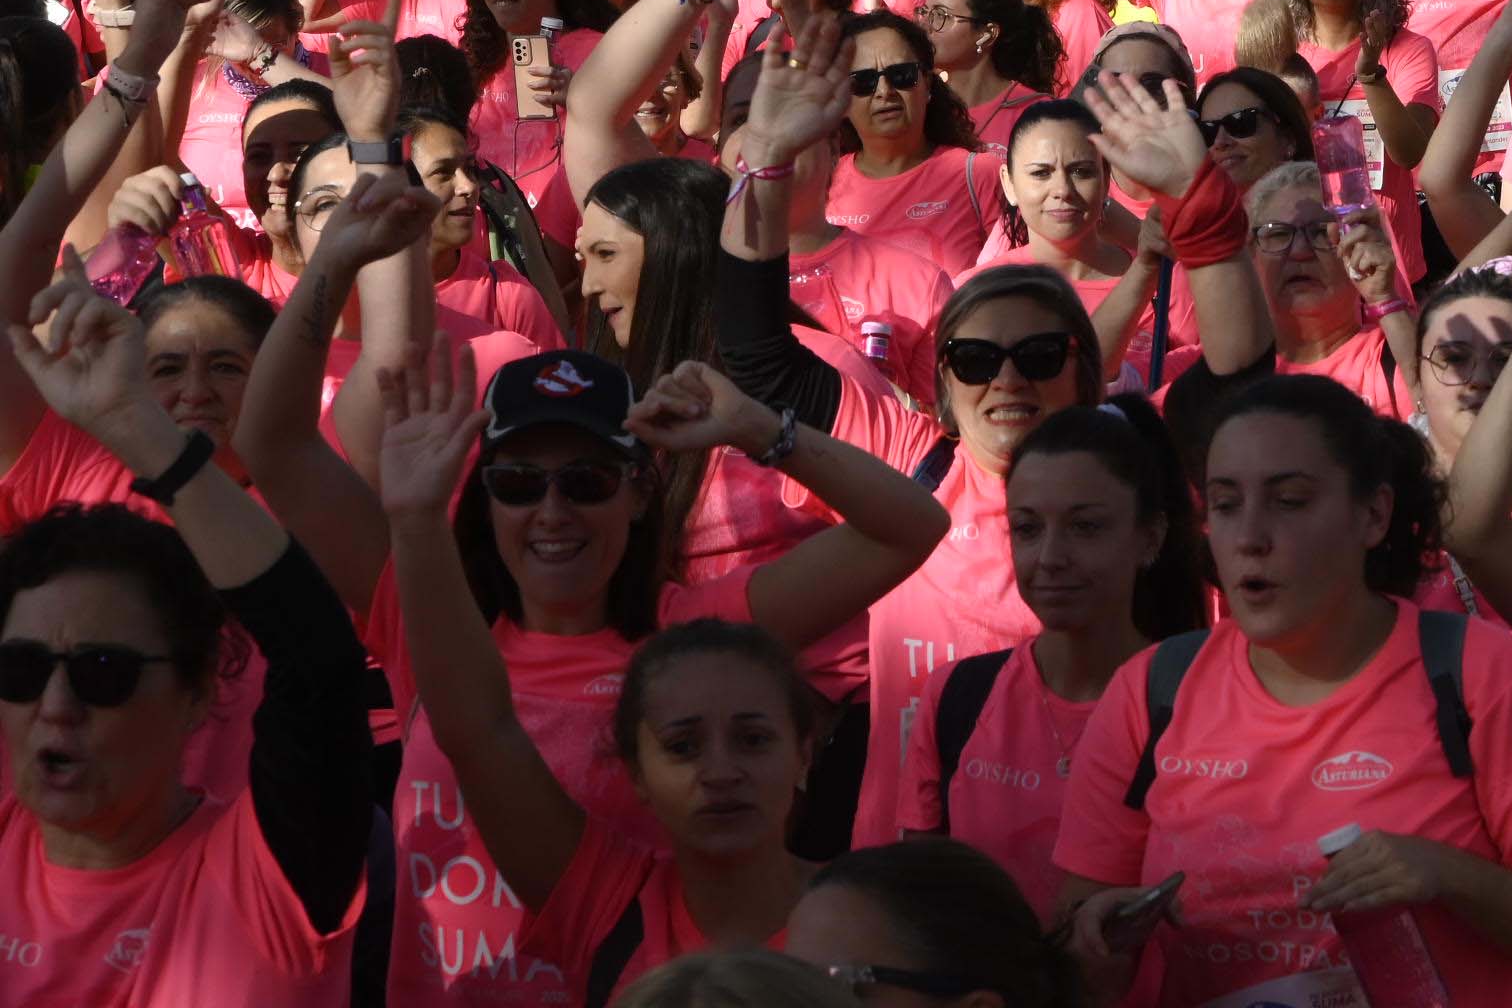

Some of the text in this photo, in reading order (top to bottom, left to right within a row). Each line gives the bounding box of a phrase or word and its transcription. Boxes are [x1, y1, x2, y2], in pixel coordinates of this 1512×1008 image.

[966, 757, 1041, 791] OYSHO
[1161, 754, 1248, 779] OYSHO
[1319, 760, 1389, 785] ASTURIANA
[411, 780, 465, 830] TU
[1248, 909, 1336, 935] TODA
